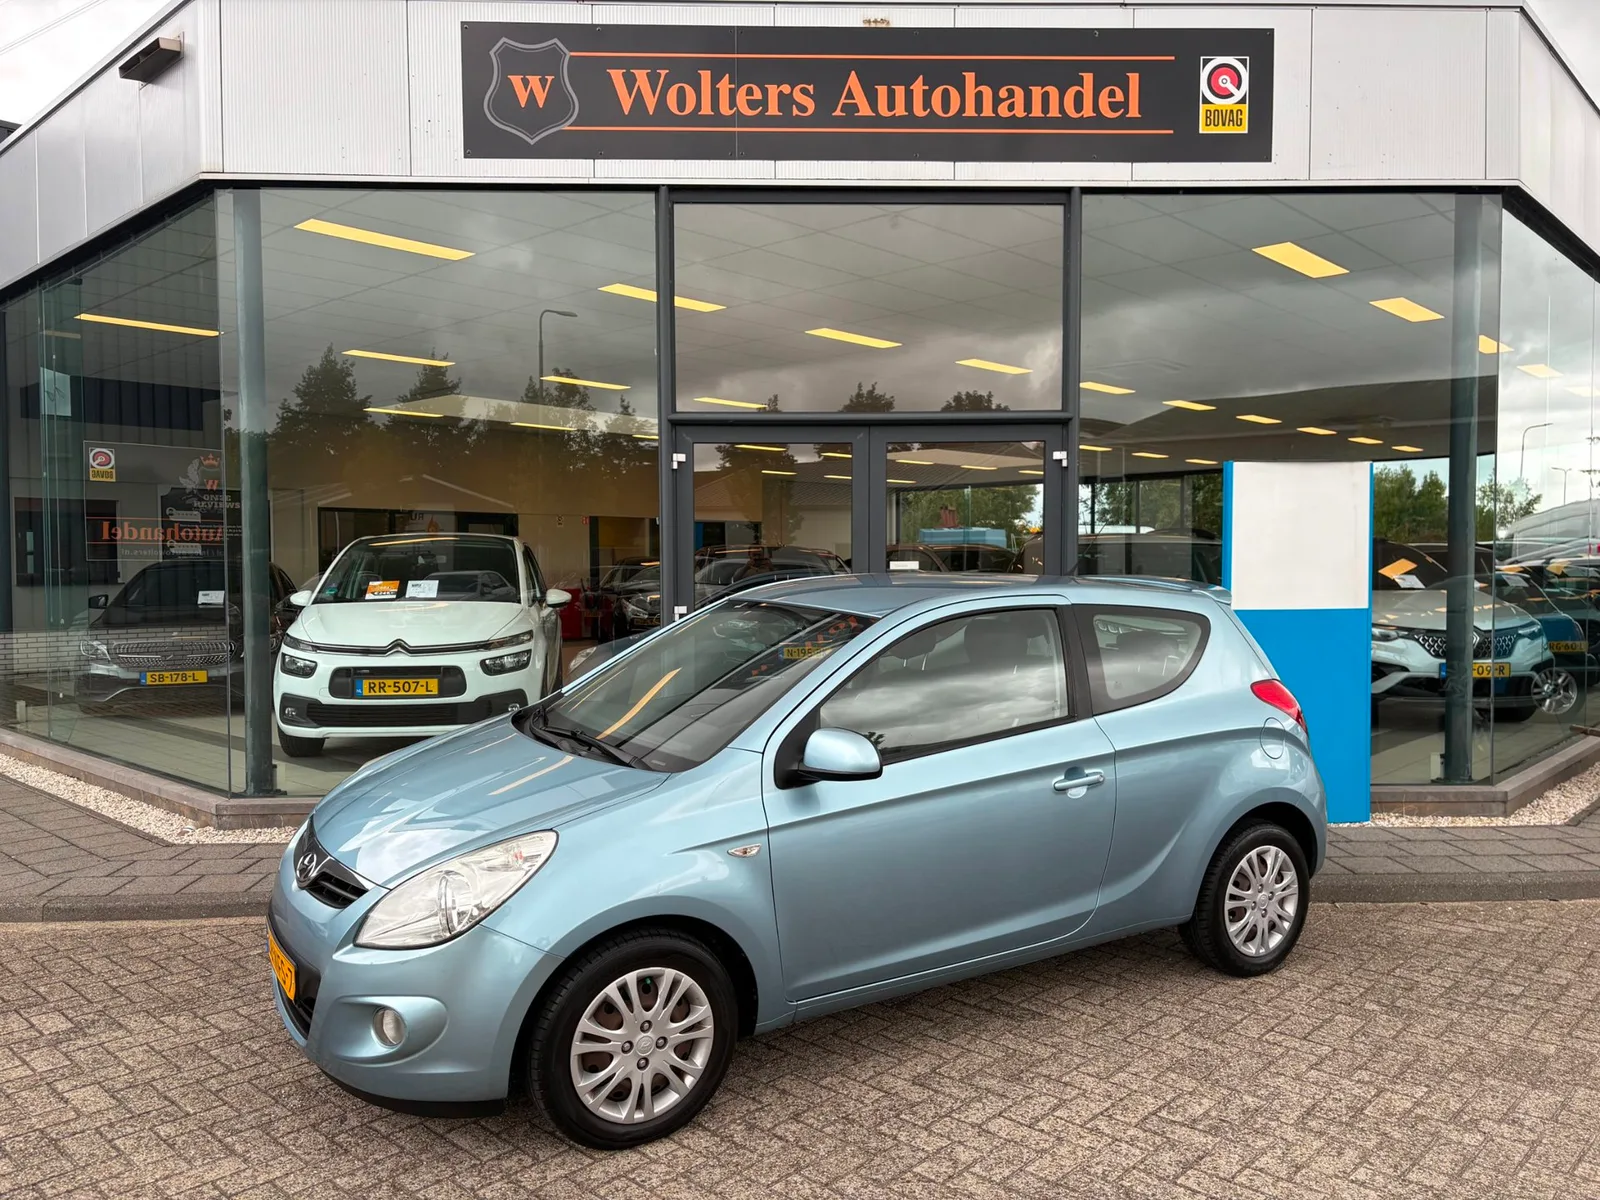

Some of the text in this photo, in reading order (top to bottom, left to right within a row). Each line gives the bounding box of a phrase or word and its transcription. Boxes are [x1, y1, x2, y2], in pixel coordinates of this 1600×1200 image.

[507, 75, 555, 109] W
[606, 68, 1142, 119] Wolters Autohandel
[1204, 108, 1244, 128] BOVAG
[150, 672, 199, 683] SB-178-L
[368, 681, 433, 694] RR-507-L
